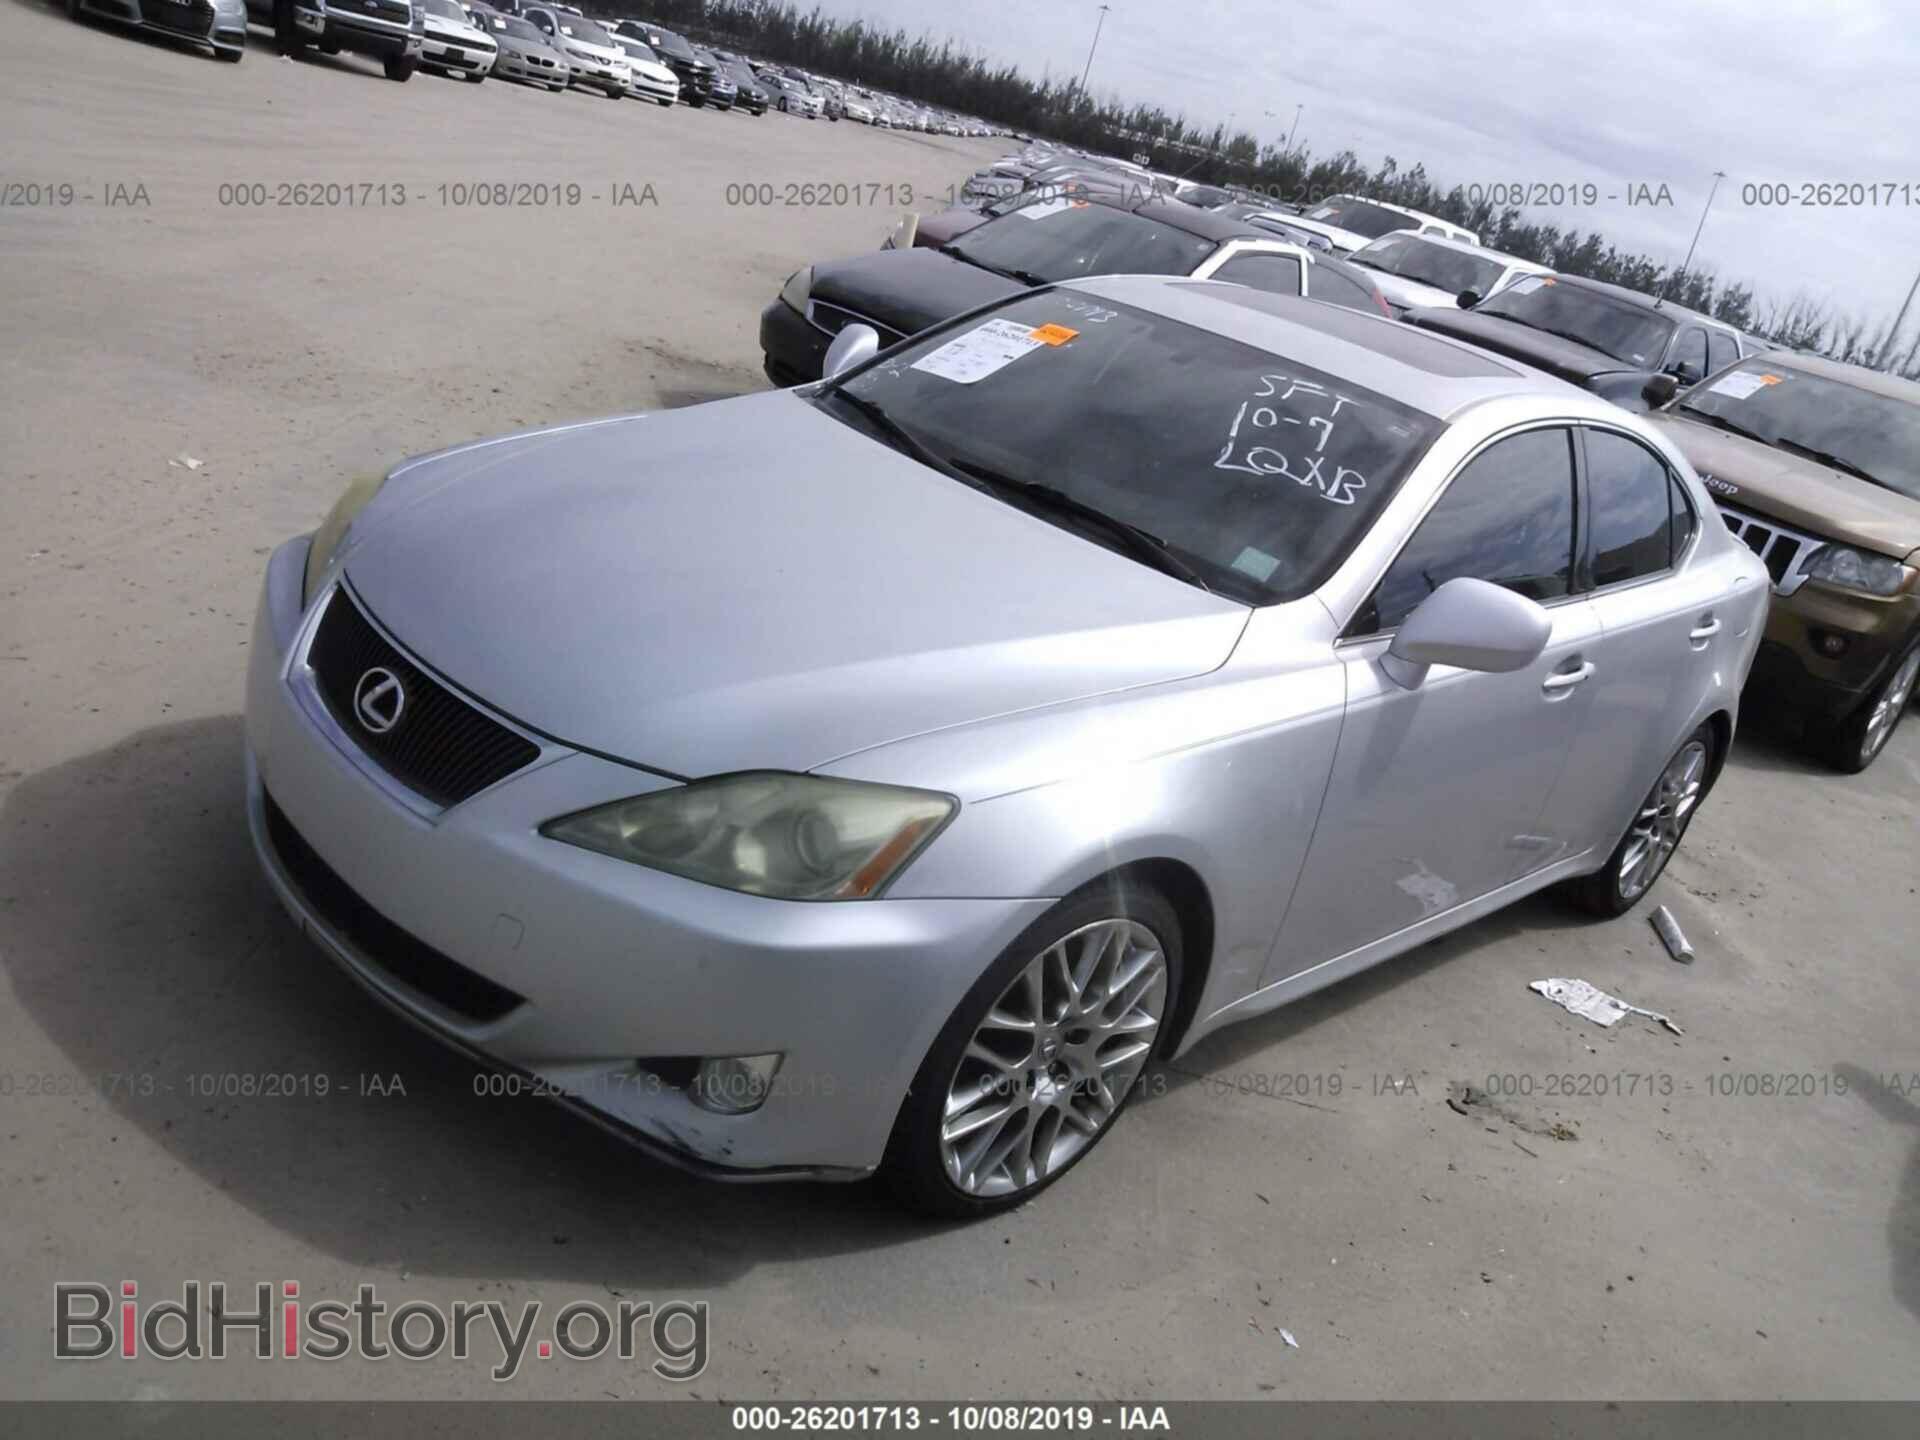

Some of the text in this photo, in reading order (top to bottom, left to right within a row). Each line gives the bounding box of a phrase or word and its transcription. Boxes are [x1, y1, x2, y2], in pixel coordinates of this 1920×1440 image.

[1254, 373, 1367, 418] SFT
[1229, 400, 1334, 452] 10-7
[1699, 473, 1739, 496] Jeep
